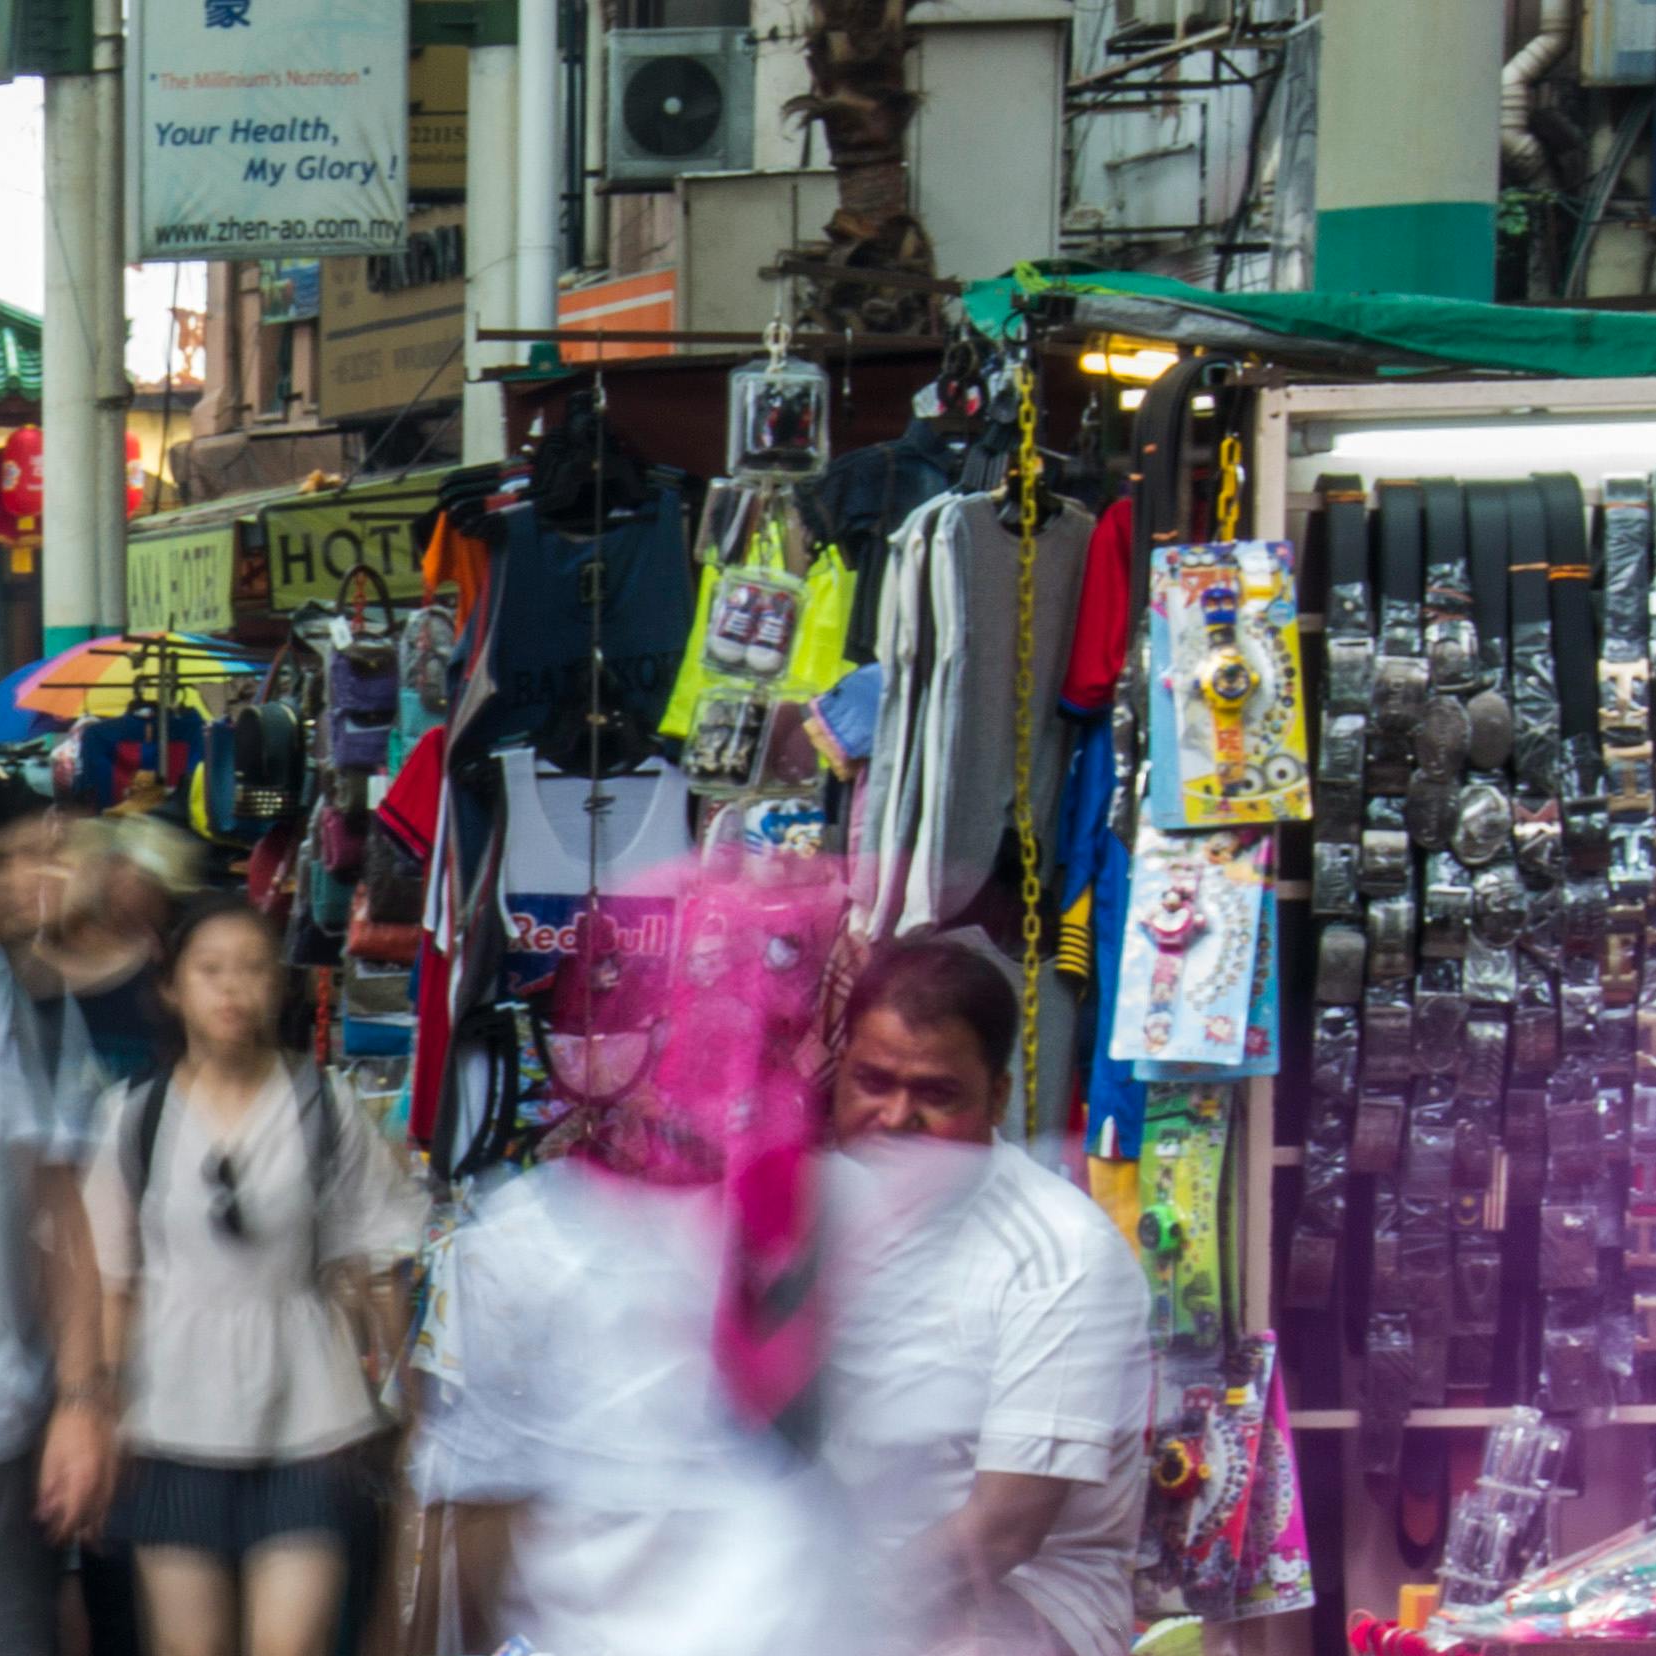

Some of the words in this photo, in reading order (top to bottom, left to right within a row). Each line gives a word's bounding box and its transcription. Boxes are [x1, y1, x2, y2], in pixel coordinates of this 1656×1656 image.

[155, 121, 220, 147] Your
[230, 117, 339, 147] Health,
[243, 157, 287, 187] My
[296, 155, 378, 186] Glory
[155, 216, 404, 246] www.zhen-ao.com.my
